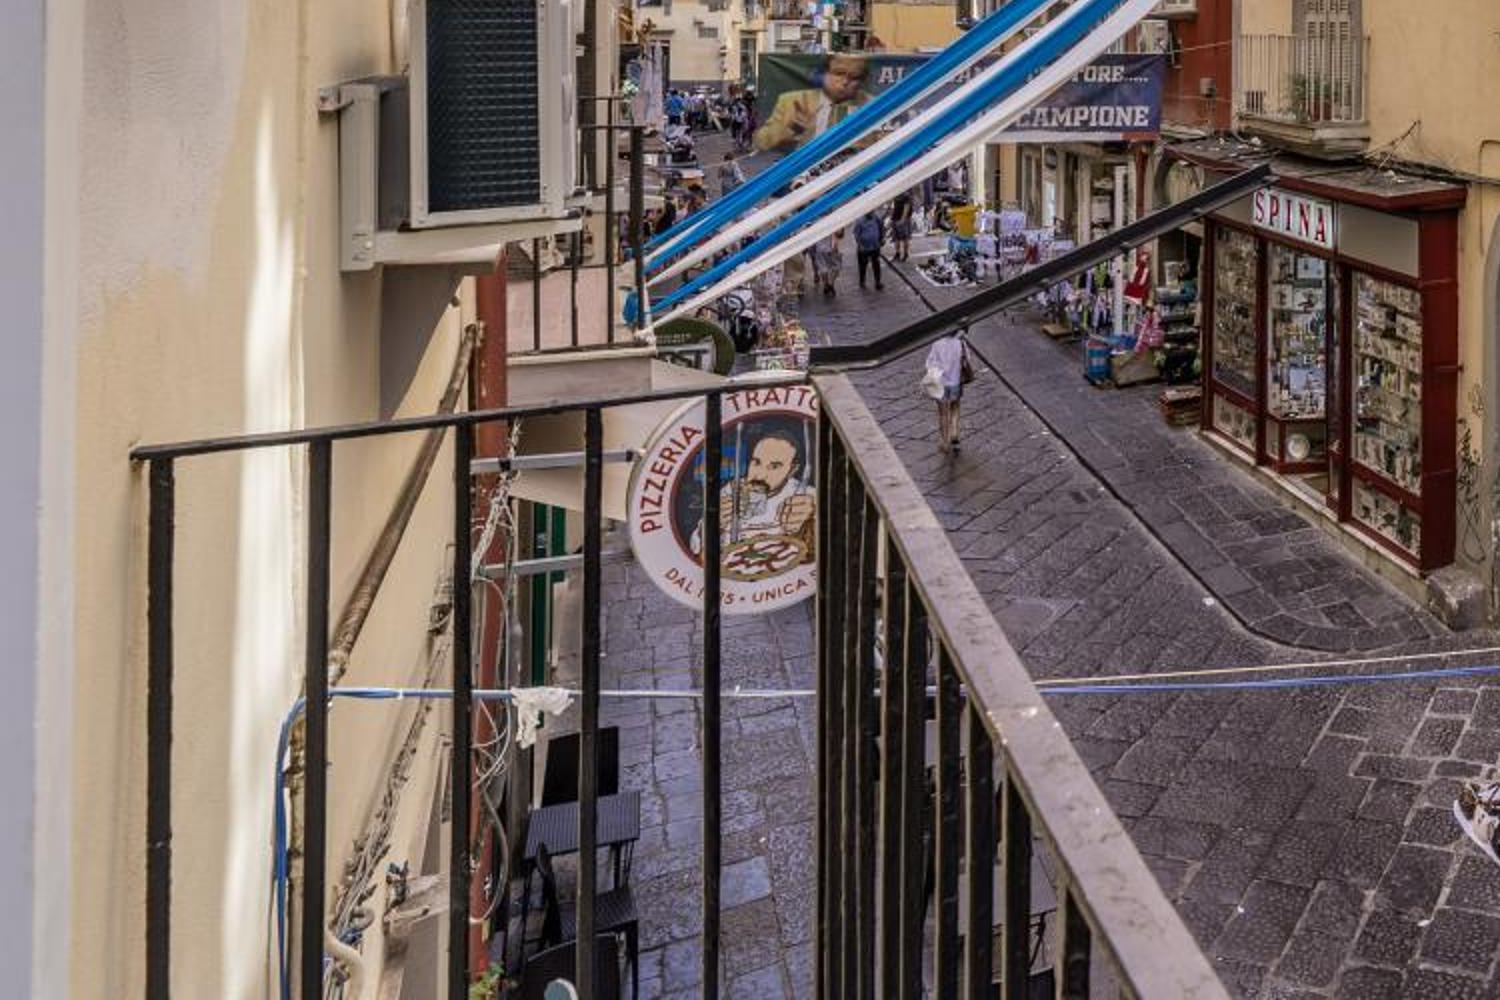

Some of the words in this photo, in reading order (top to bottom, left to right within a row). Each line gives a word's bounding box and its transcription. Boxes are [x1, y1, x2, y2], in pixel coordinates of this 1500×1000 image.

[1018, 105, 1149, 128] CAMPIONE
[1254, 188, 1328, 244] SPINA
[639, 424, 702, 534] PIZZERIA
[664, 567, 693, 595] DAL
[751, 578, 808, 604] UNICA
